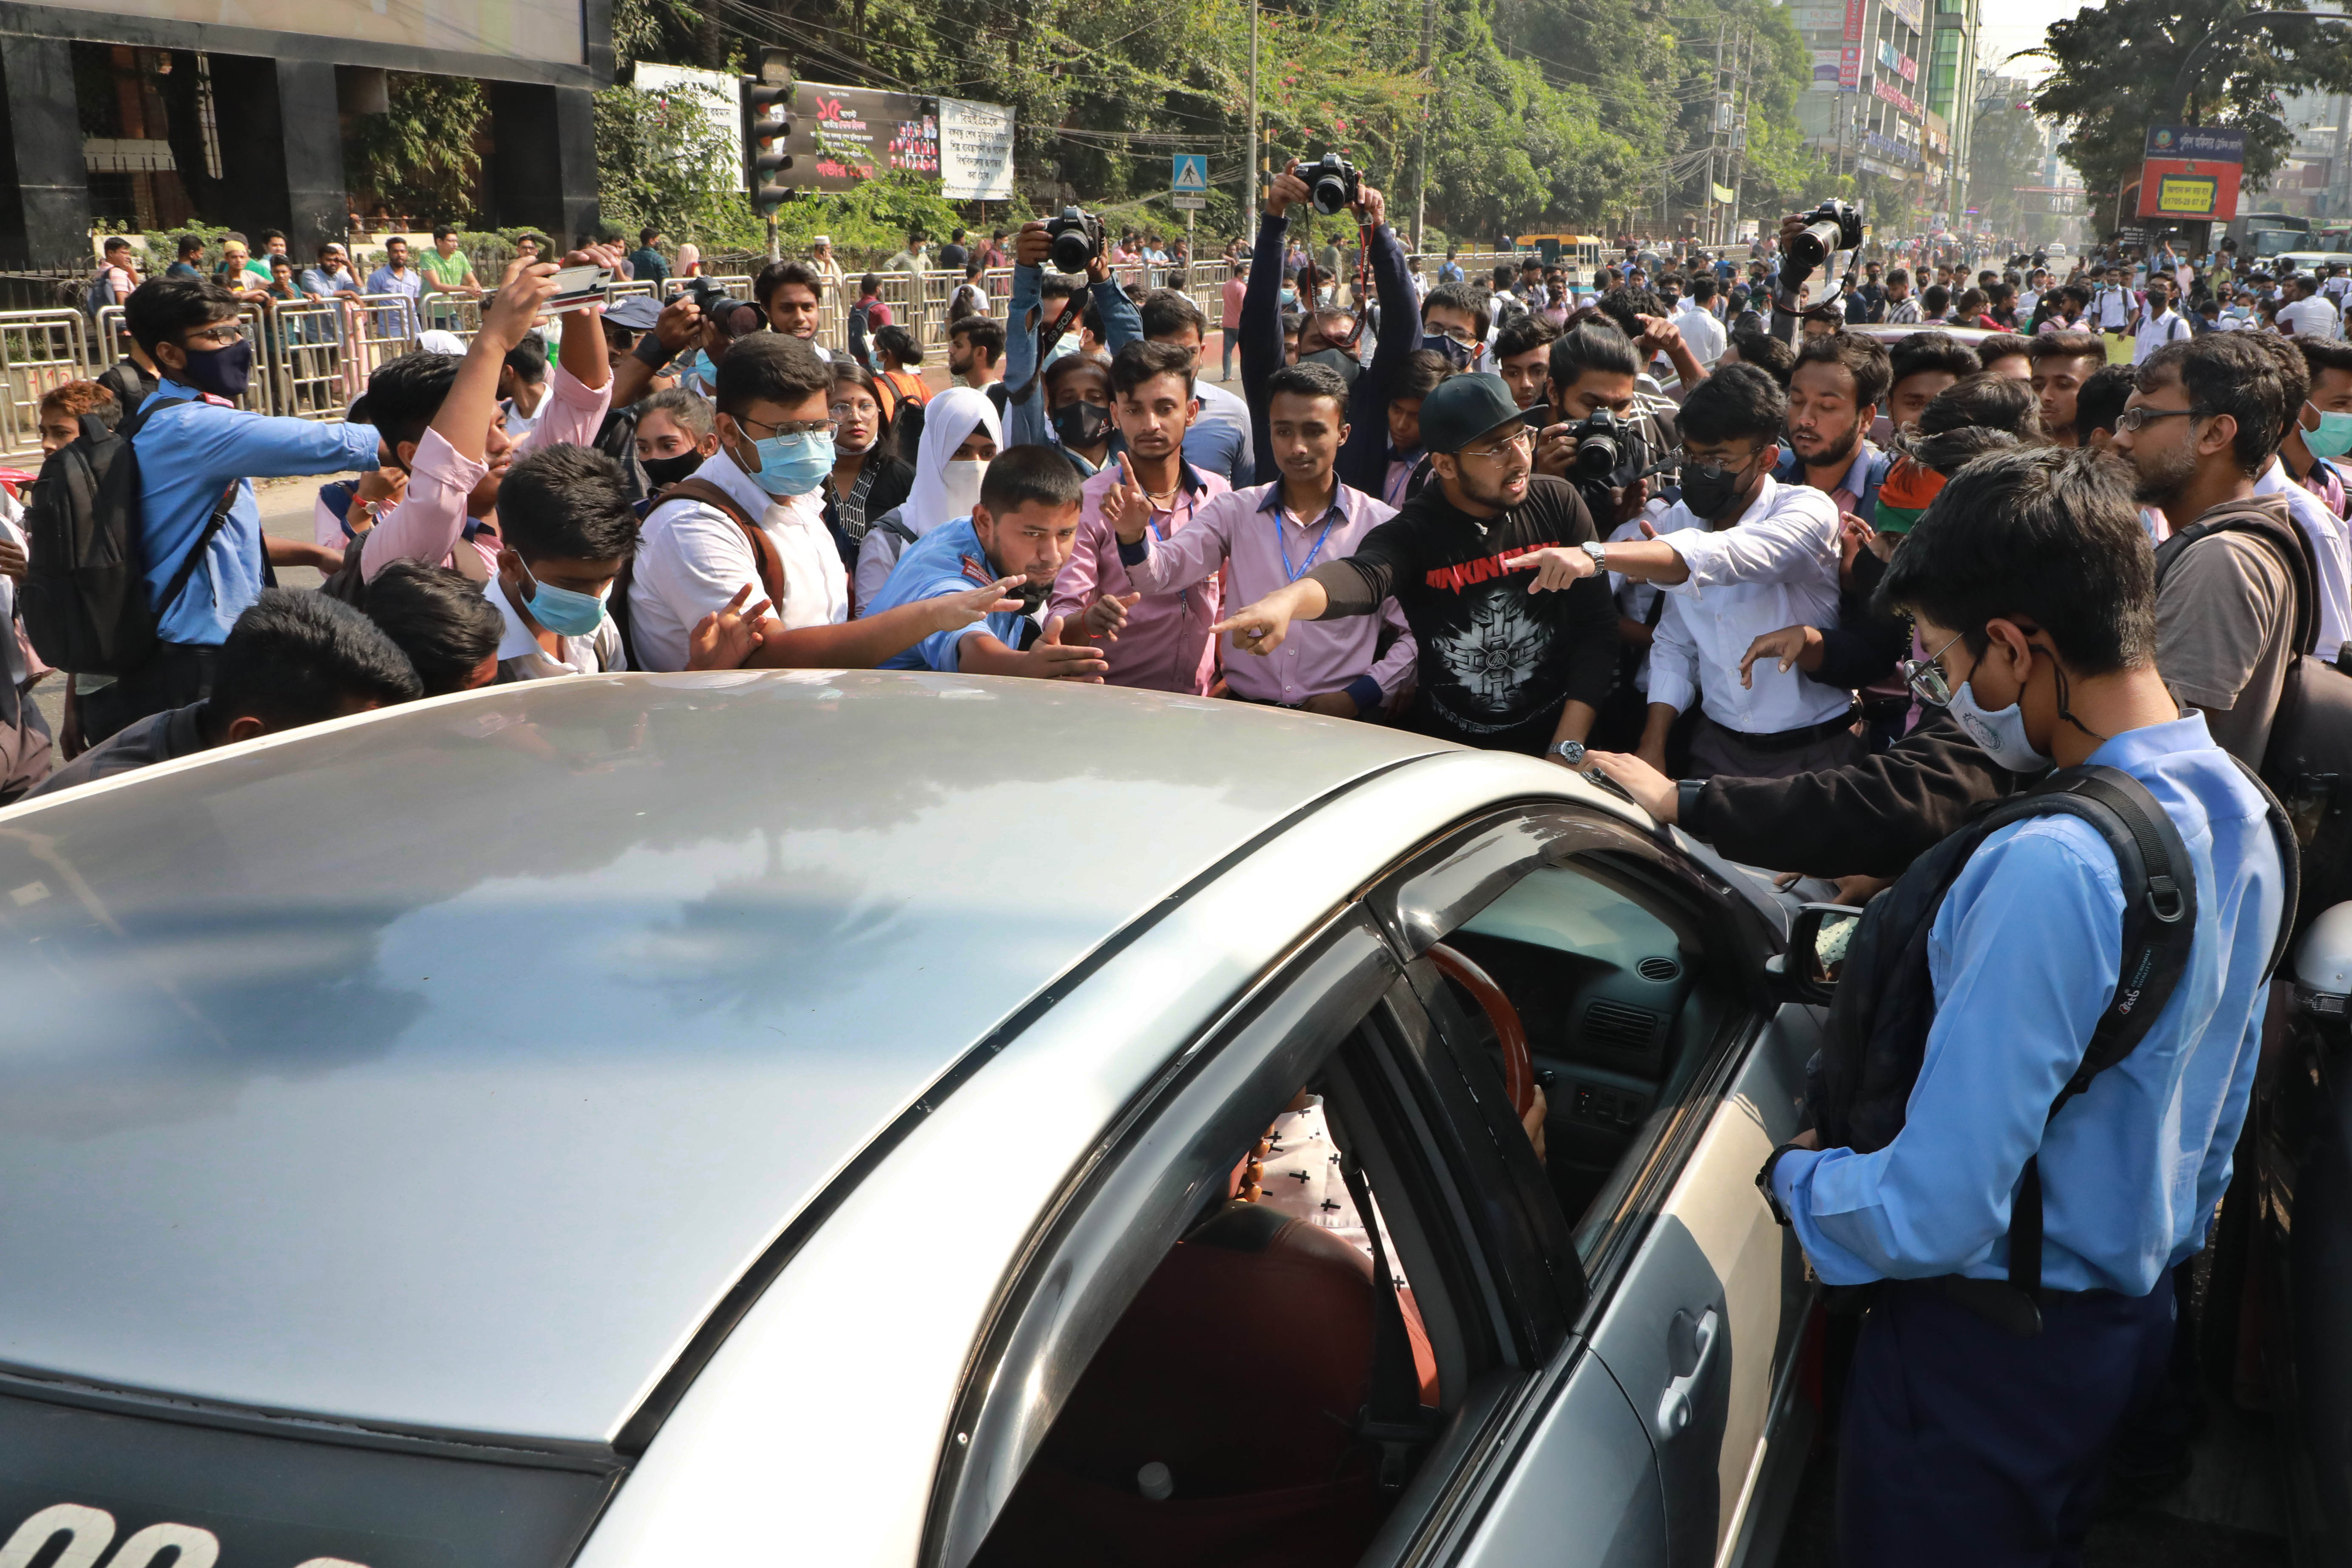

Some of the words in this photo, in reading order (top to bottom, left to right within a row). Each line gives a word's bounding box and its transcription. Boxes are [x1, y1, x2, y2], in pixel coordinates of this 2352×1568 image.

[709, 108, 731, 118] রহমান
[816, 96, 843, 121] ১৫
[948, 129, 964, 139] বঙ্গবন্ধু
[965, 130, 976, 139] শেখ
[977, 129, 994, 142] মুজিবুর
[816, 159, 847, 178] গভীর
[967, 171, 977, 180] করা
[1056, 311, 1073, 332] EOS
[1048, 330, 1058, 342] 6D
[2131, 948, 2152, 987] DEPENDABLE
[2136, 961, 2152, 988] QUALITY
